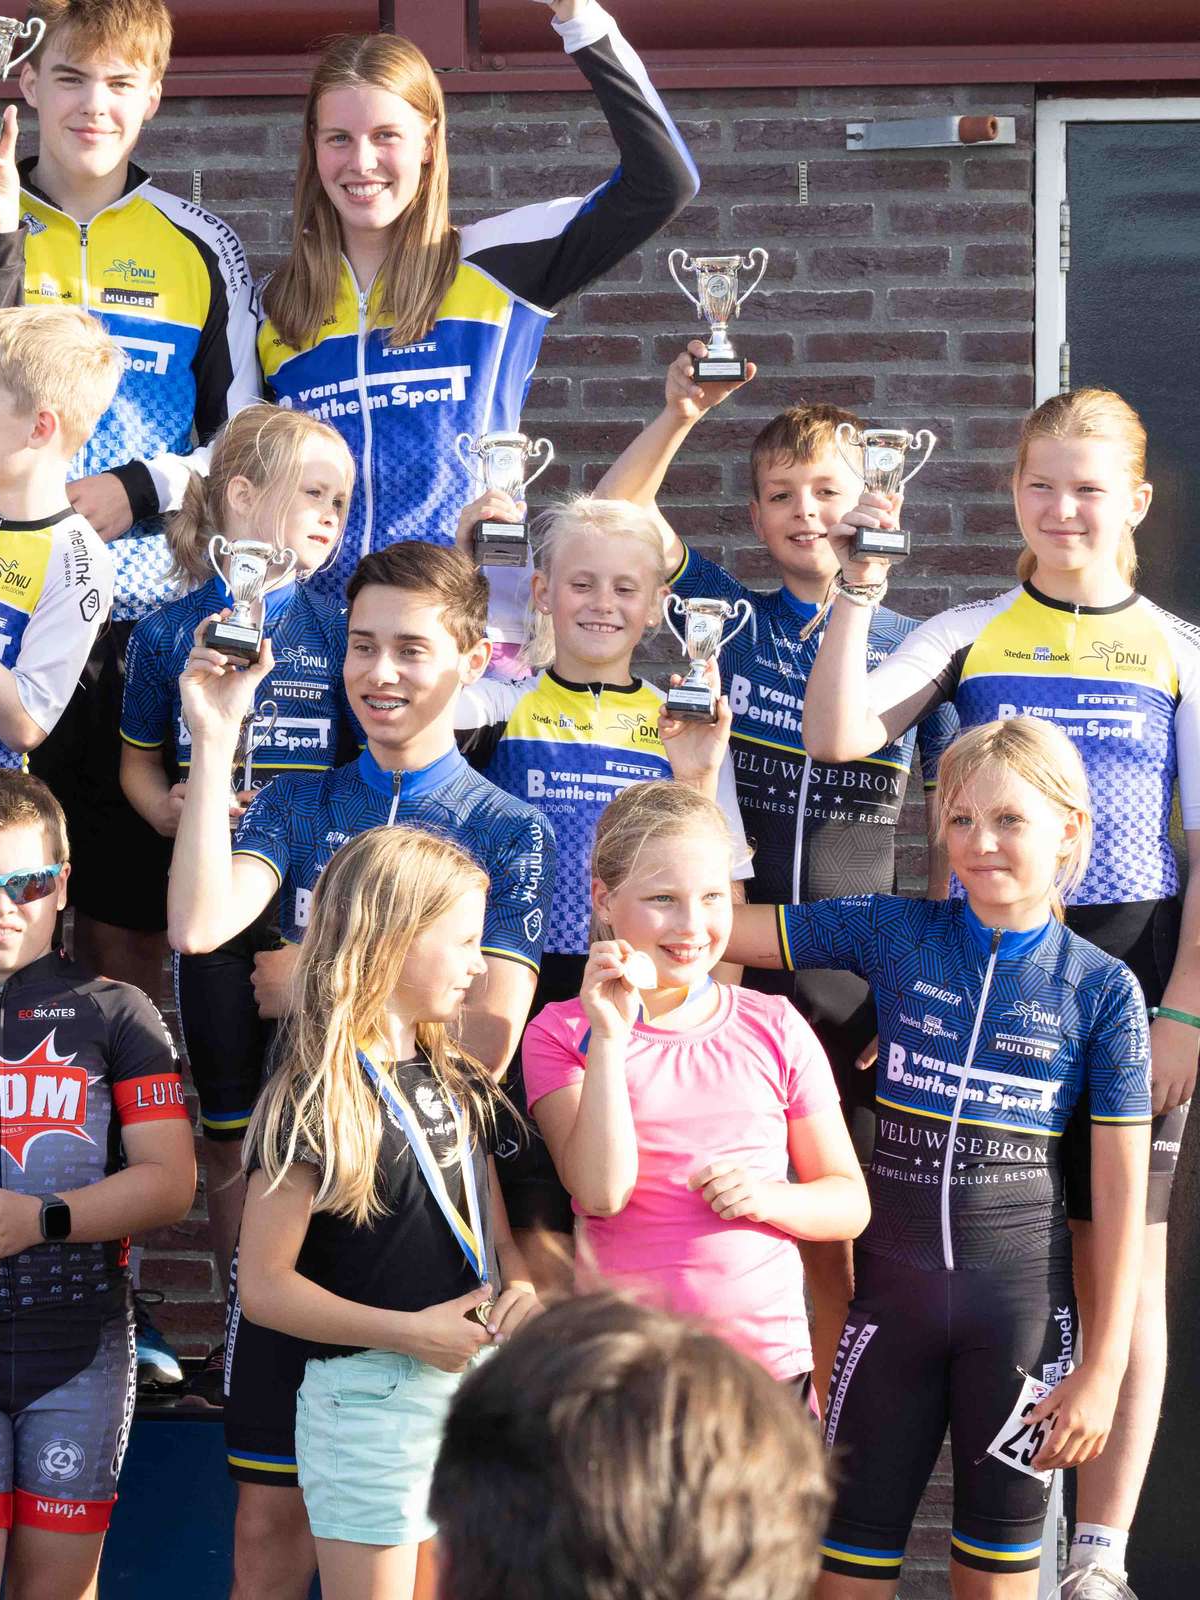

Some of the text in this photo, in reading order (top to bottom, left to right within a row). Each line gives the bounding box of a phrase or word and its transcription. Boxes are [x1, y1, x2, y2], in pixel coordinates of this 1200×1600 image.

[180, 200, 249, 287] mennink
[131, 267, 156, 279] DNIJ
[105, 293, 154, 308] MULDER
[299, 382, 337, 402] van
[68, 529, 92, 586] mennink
[4, 571, 32, 589] DNIJ
[301, 655, 328, 669] DNIJ
[1003, 648, 1071, 662] Steden Driehoek
[1115, 651, 1148, 666] DNIJ
[273, 687, 323, 700] MULDER
[1022, 705, 1054, 718] van
[527, 768, 612, 802] Benthem
[550, 771, 582, 783] van
[803, 808, 854, 822] DELUXE
[521, 821, 545, 905] mennink
[913, 980, 963, 1007] BIORACER
[1032, 1010, 1062, 1028] DNIJ
[922, 1023, 960, 1042] Driehoek
[995, 1040, 1051, 1061] MULDER
[911, 1051, 947, 1072] van
[886, 1042, 985, 1104] Benthem
[877, 1167, 939, 1185] BEWELLNESS
[950, 1174, 999, 1186] DELUXE
[1004, 1167, 1049, 1183] RESORT
